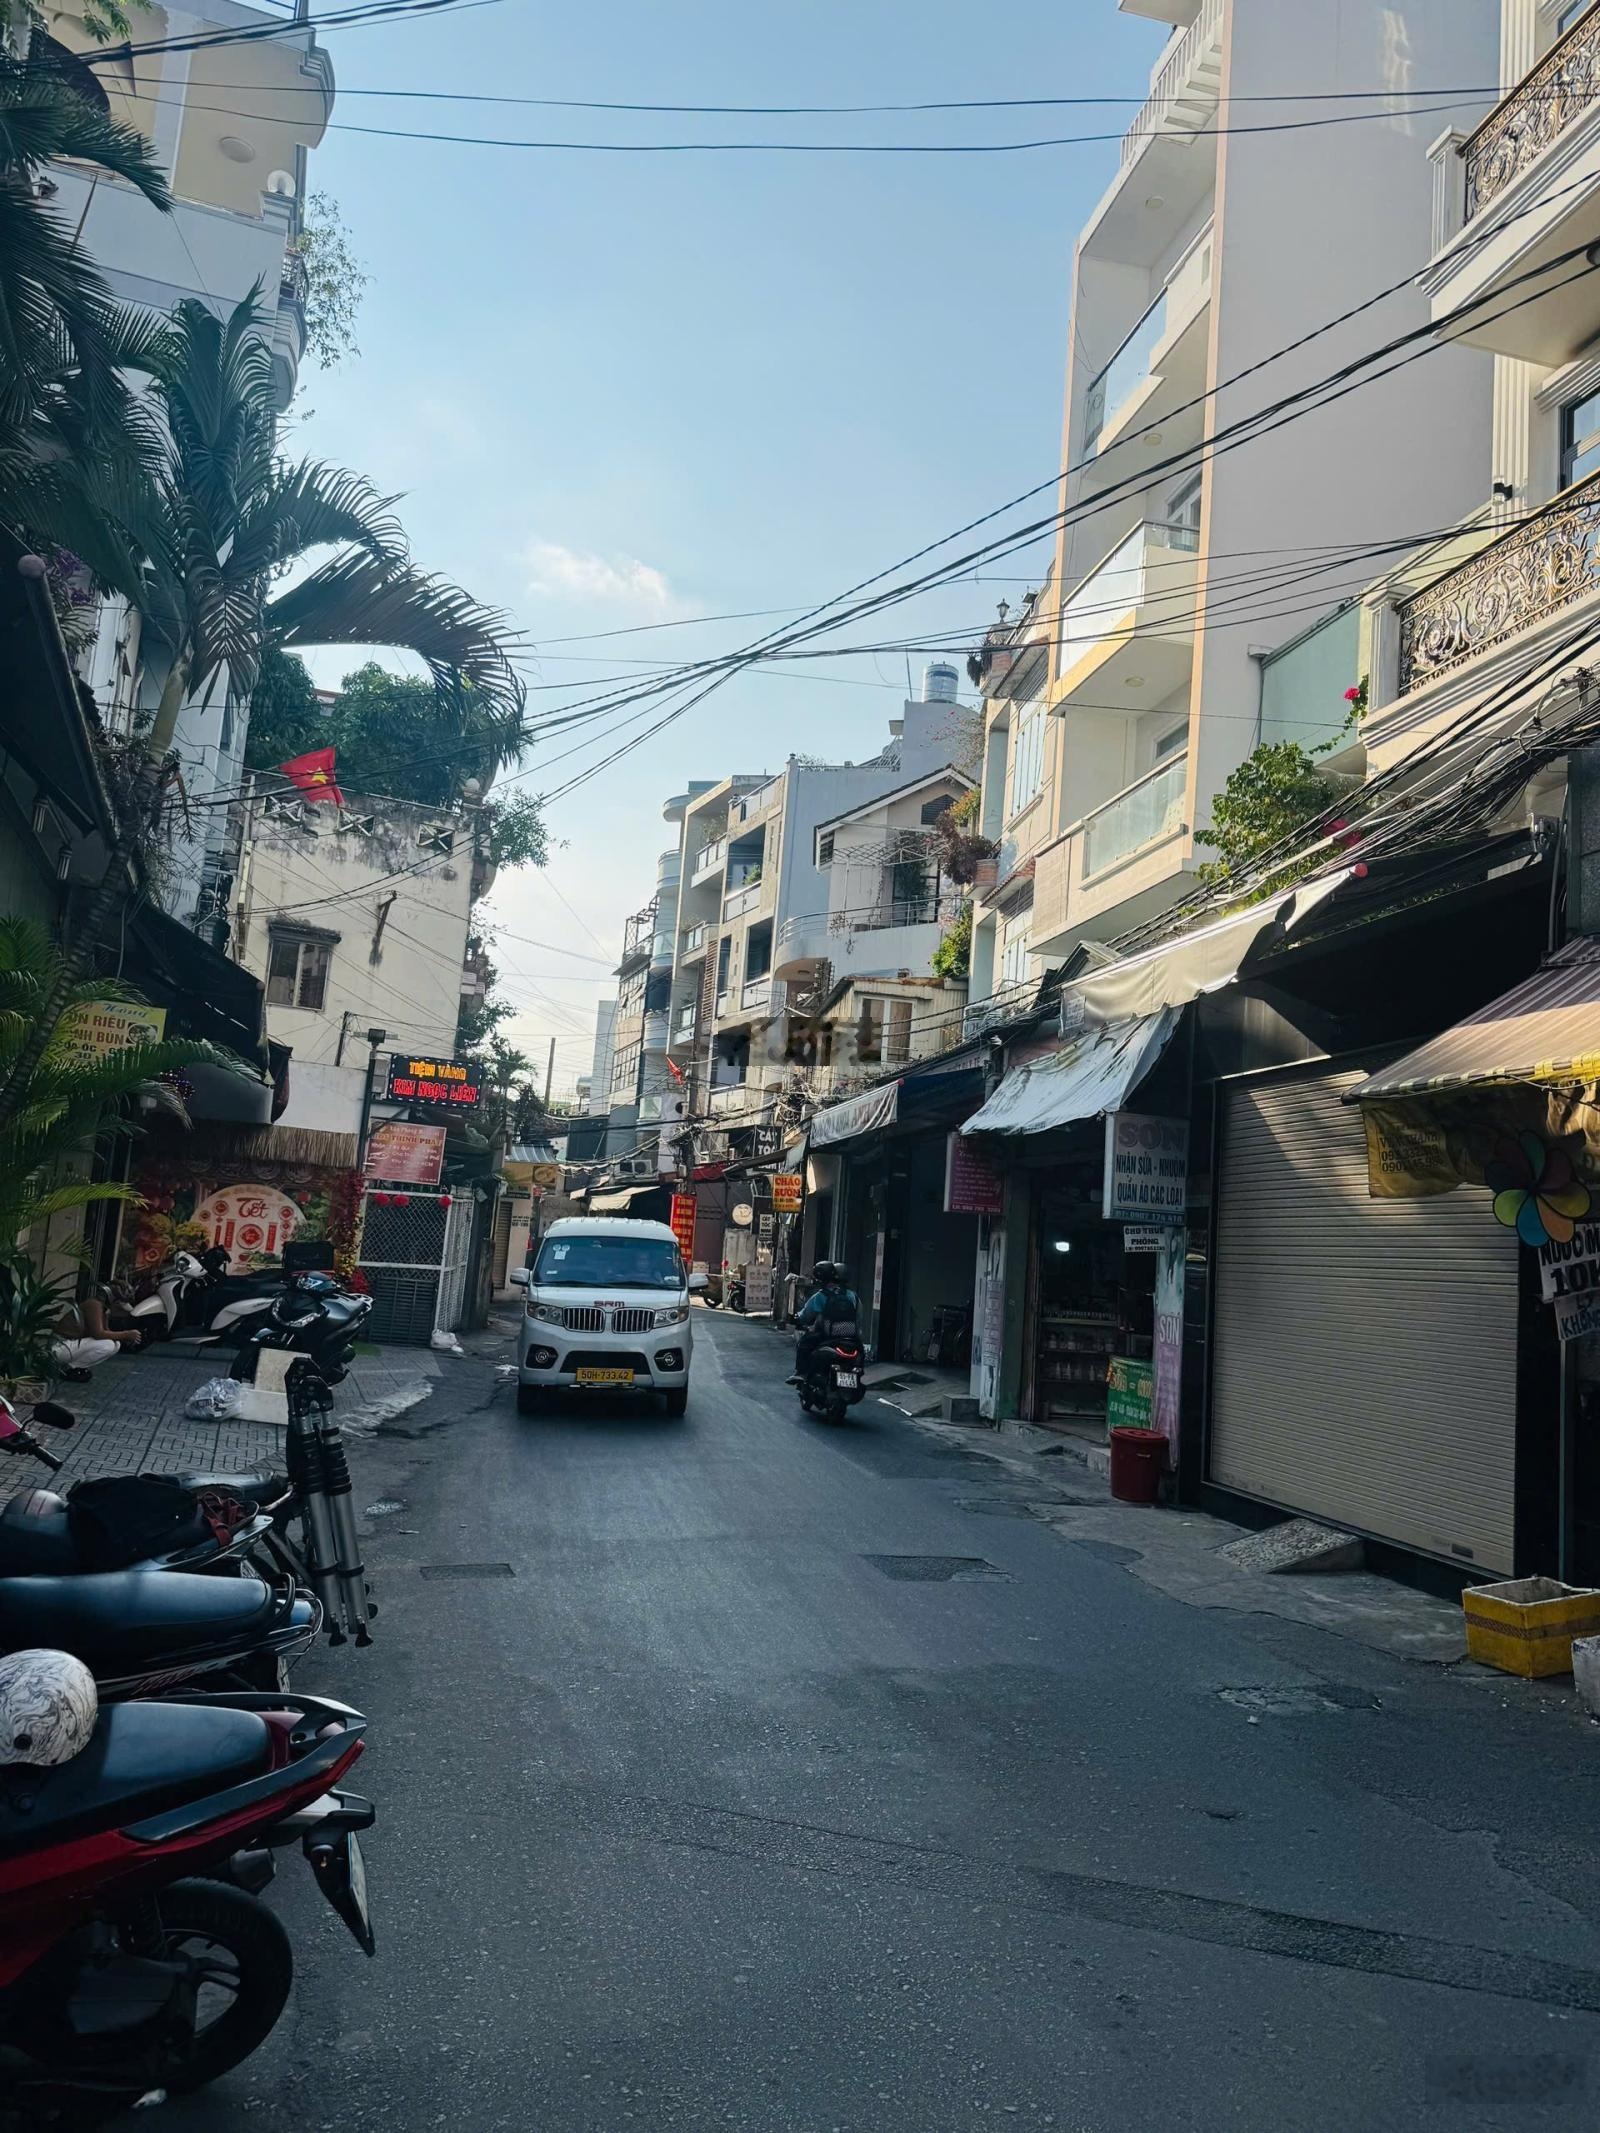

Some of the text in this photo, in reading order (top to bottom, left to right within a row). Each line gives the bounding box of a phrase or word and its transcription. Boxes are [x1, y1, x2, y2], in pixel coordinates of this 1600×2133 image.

[95, 1030, 125, 1045] BÚN
[393, 1078, 477, 1103] KIM NGỌC LIÊN
[236, 1198, 269, 1219] Tết
